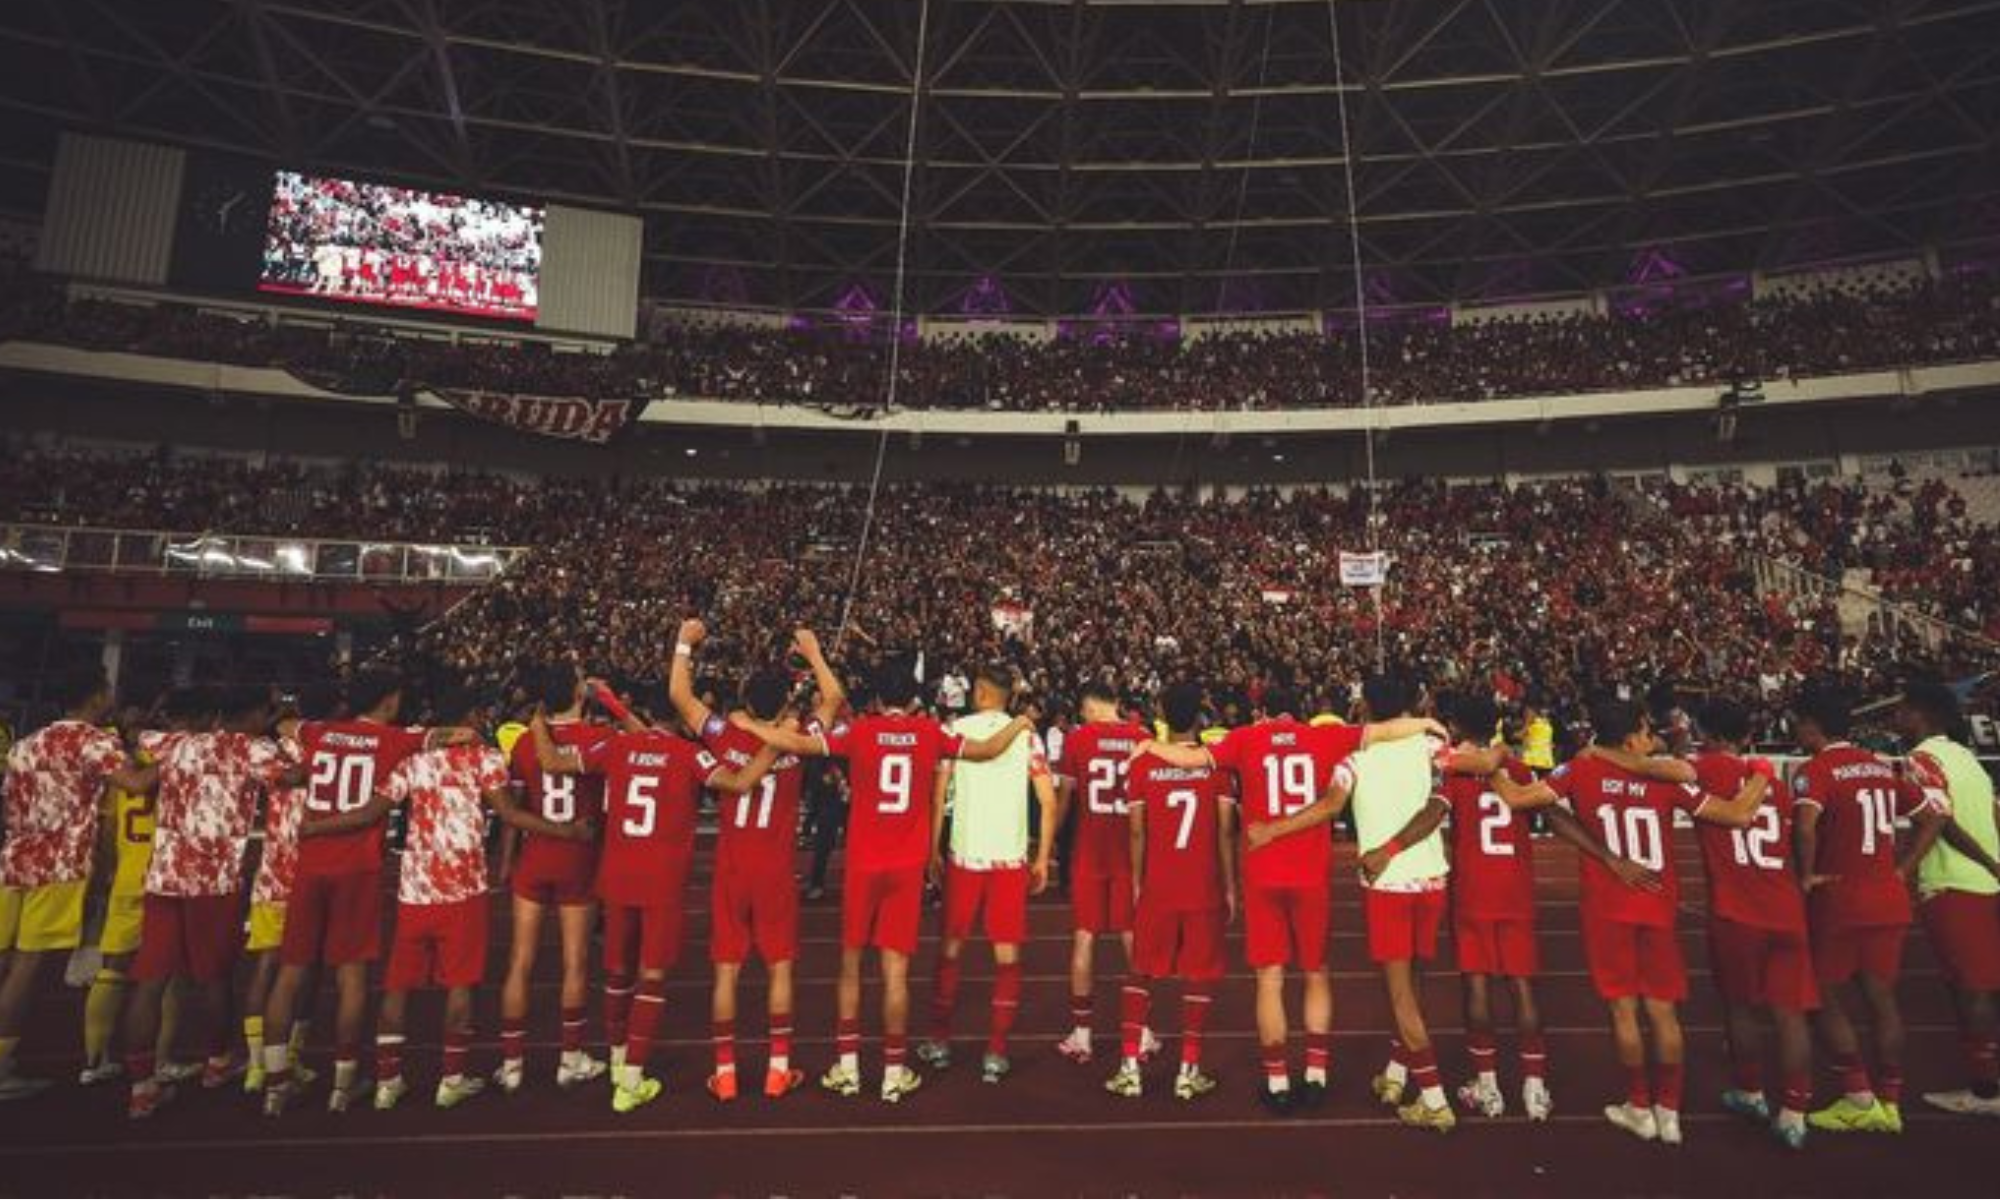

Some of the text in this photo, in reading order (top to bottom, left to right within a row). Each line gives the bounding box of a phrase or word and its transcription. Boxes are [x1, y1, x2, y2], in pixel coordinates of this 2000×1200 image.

[187, 616, 214, 629] Exit
[306, 751, 375, 813] 20
[542, 771, 576, 823] 8
[622, 774, 660, 837] 5
[877, 753, 913, 814] 9
[1262, 753, 1317, 816] 19
[1166, 790, 1198, 850] 7
[1479, 791, 1516, 856] 2
[1596, 803, 1664, 871] 10
[1731, 804, 1784, 870] 12
[1855, 787, 1897, 855] 14
